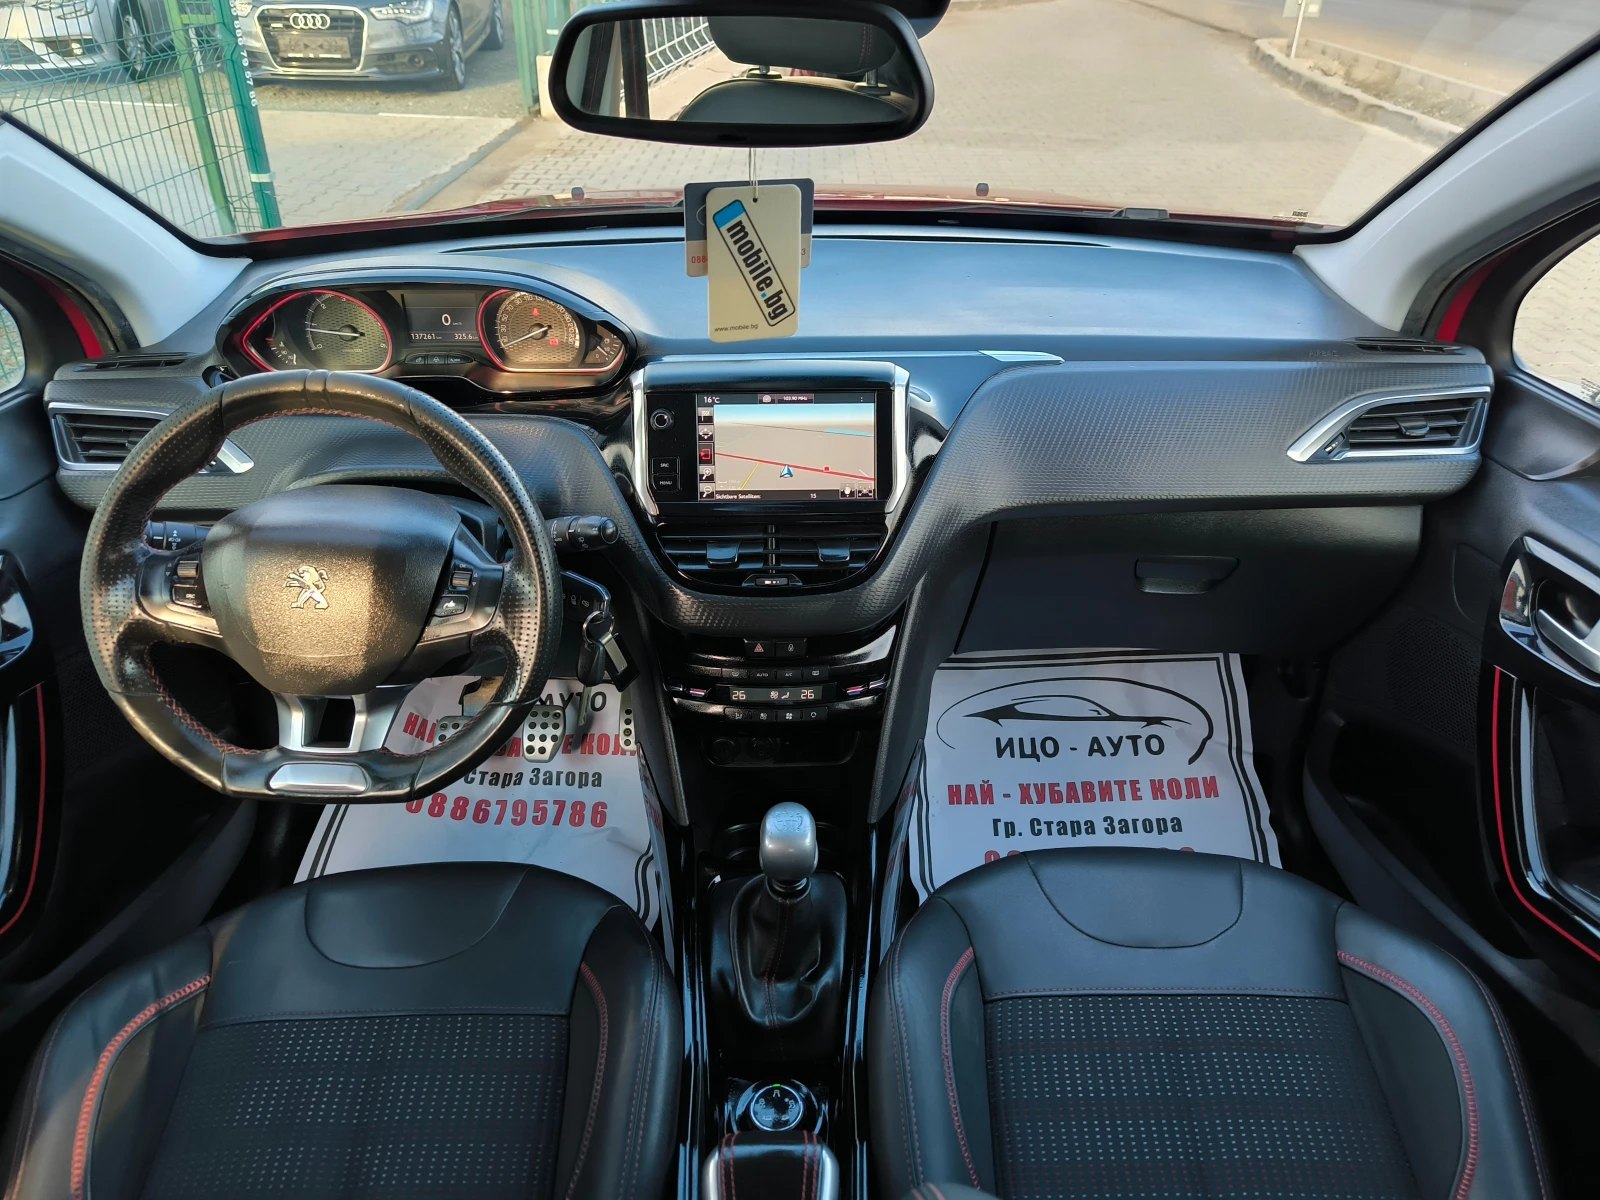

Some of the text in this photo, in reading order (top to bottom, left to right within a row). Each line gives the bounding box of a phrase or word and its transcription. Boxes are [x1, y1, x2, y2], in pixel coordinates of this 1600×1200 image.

[249, 90, 258, 107] 86
[726, 220, 788, 321] mobile.bg
[442, 314, 451, 326] 0
[714, 323, 758, 332] www.mobile.bg
[732, 690, 746, 700] 26
[801, 690, 814, 699] 26
[995, 736, 1060, 762] ИЦО
[1087, 734, 1165, 757] АУТО
[464, 767, 602, 788] Стара Загора
[947, 780, 995, 805] НАЙ
[1018, 779, 1143, 805] ХУБАВИТЕ
[1150, 776, 1220, 800] КОЛИ
[405, 793, 608, 828] 0886795786
[992, 816, 1183, 839] Гр. Стара Загора
